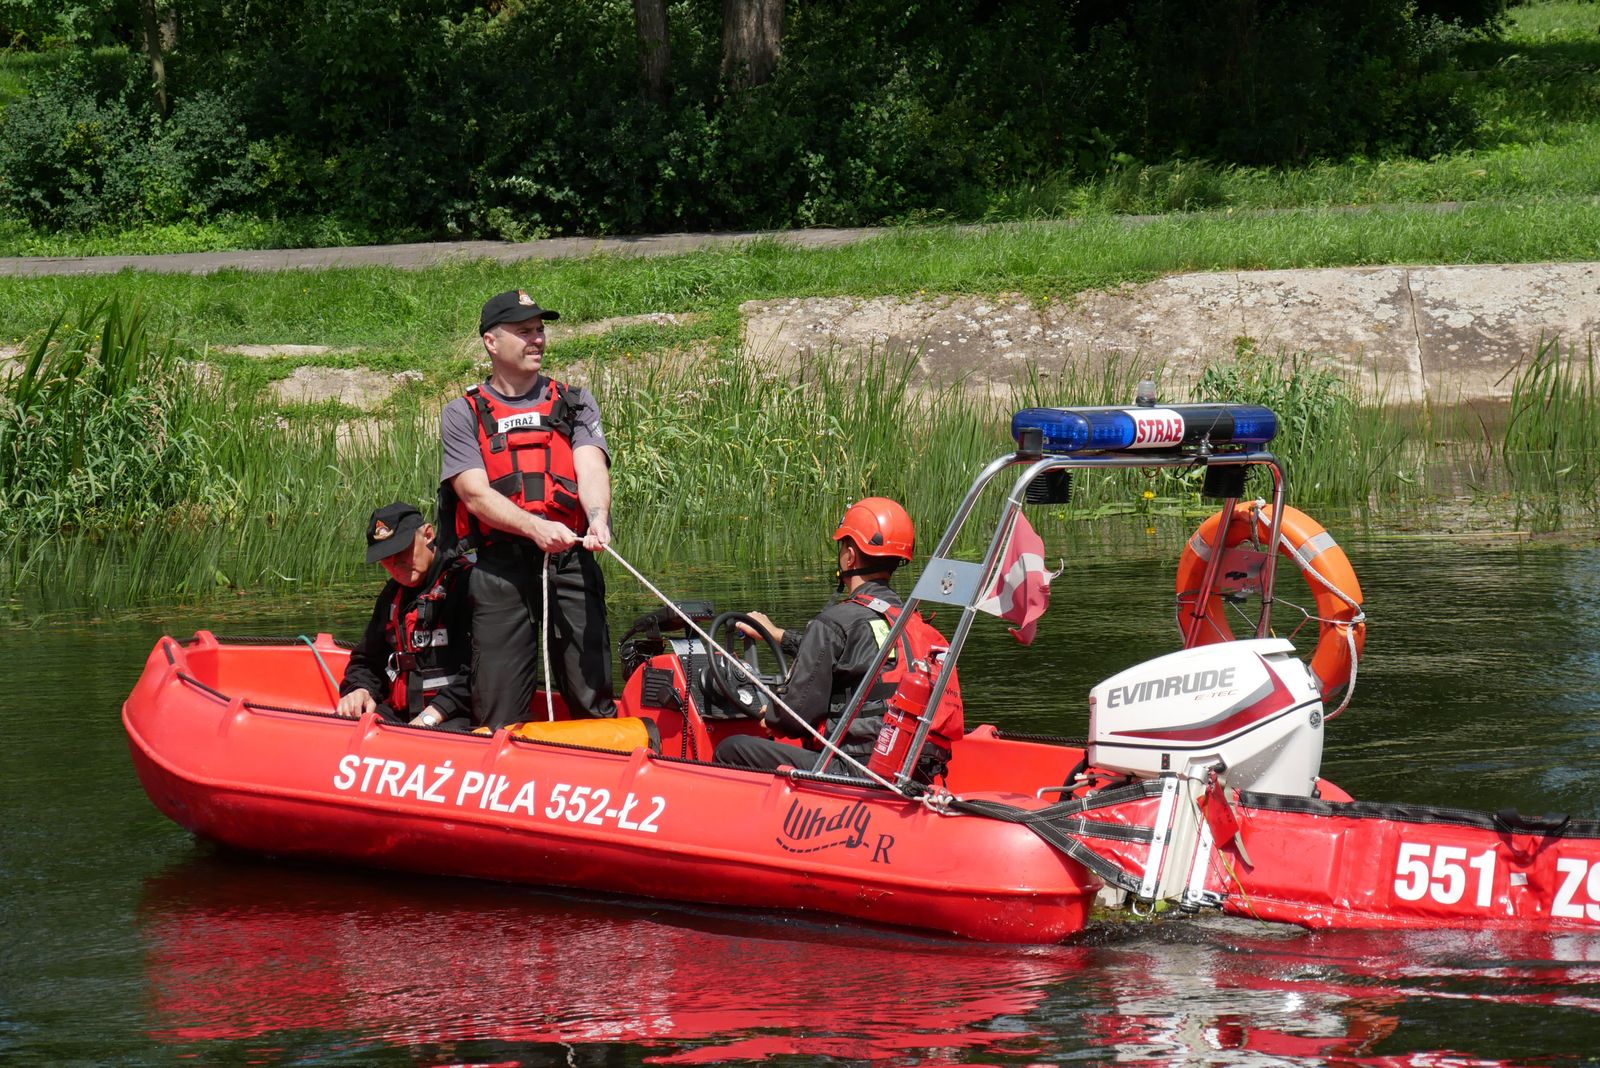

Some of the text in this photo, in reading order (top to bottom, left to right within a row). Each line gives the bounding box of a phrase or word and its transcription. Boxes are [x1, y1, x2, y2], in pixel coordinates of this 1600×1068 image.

[1107, 667, 1236, 708] EVINRUDE
[333, 754, 666, 833] STRAŻ PIŁA 552-Ł2
[870, 833, 895, 865] R
[1394, 842, 1497, 908] 551
